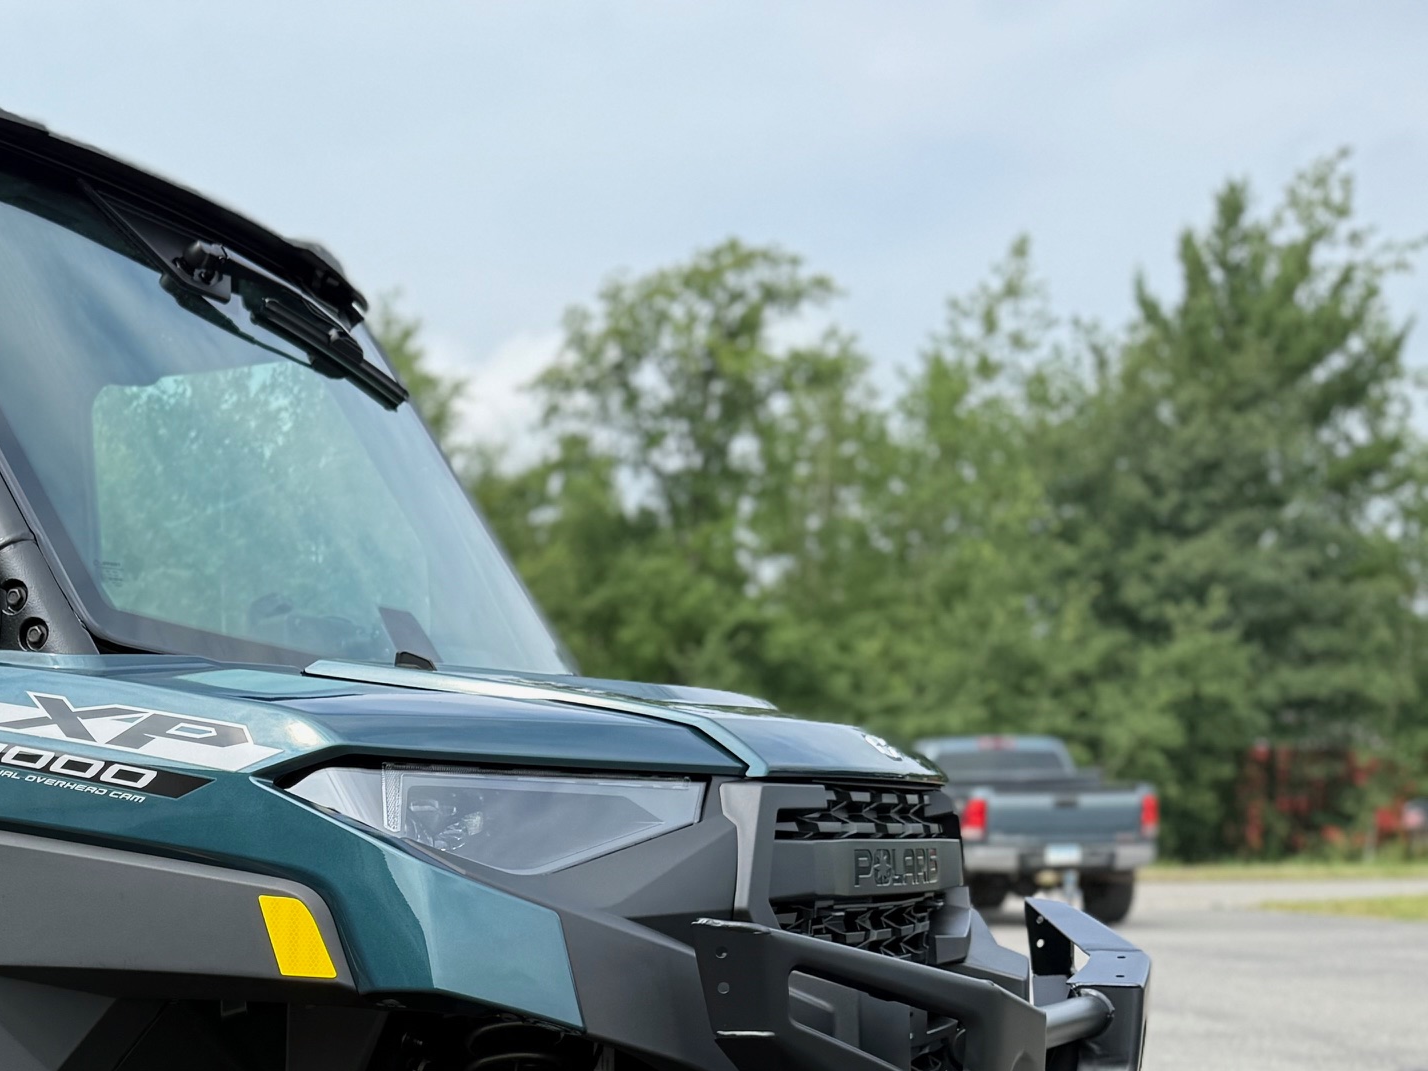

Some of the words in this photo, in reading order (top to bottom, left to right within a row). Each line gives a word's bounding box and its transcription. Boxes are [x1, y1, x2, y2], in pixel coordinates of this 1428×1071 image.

[25, 774, 108, 796] OVERHEAD
[109, 790, 146, 803] CAM
[854, 847, 939, 888] POLARIS
